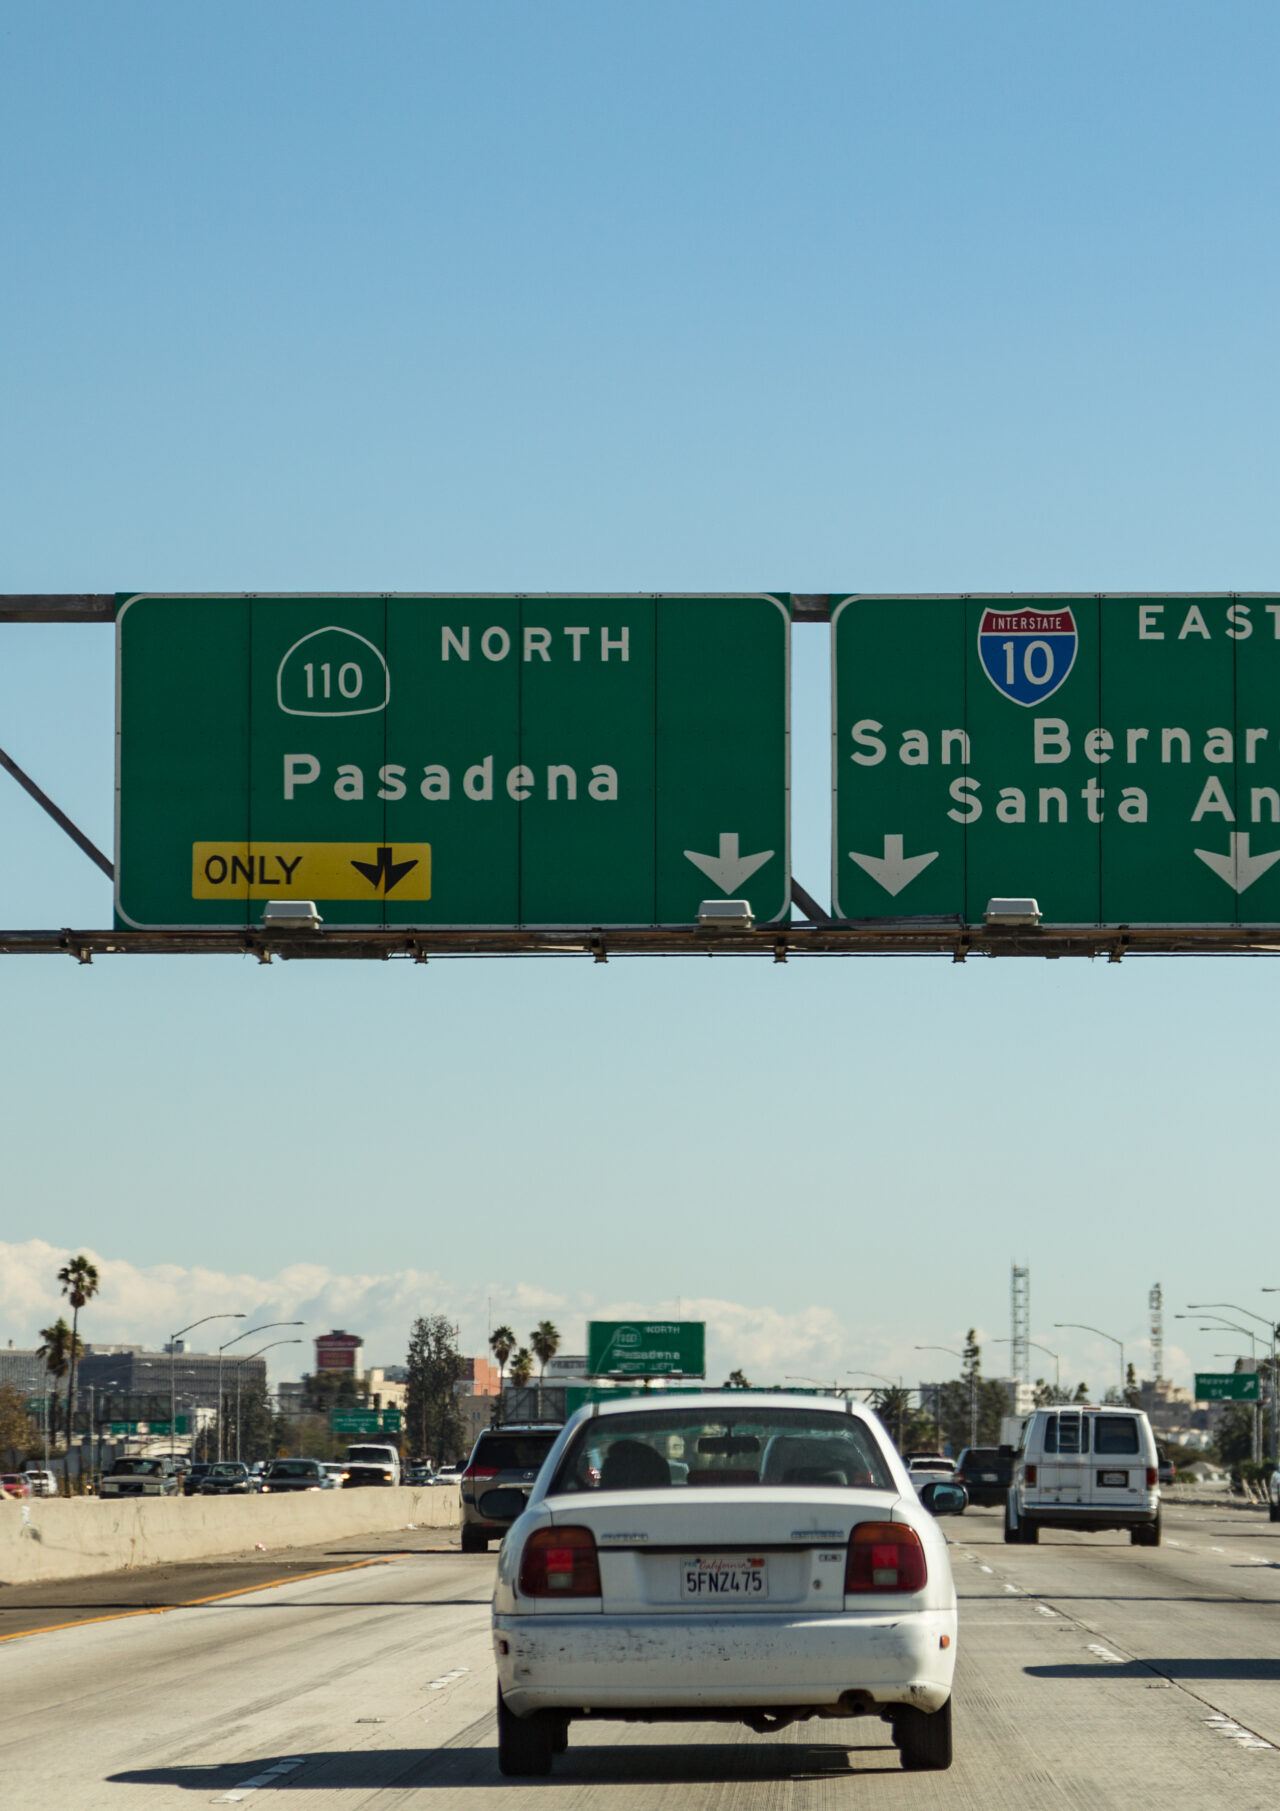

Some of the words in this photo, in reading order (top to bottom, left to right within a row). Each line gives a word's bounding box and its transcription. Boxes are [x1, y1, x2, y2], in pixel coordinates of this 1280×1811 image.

[992, 616, 1062, 630] INTERSTATE
[441, 626, 630, 663] NORTH
[1002, 640, 1055, 686] 10
[304, 662, 364, 700] 110
[850, 719, 972, 767] San
[283, 754, 619, 802] Pasadena
[947, 777, 1149, 824] Santa
[205, 855, 303, 885] ONLY
[686, 1571, 762, 1593] 5FNZ475
